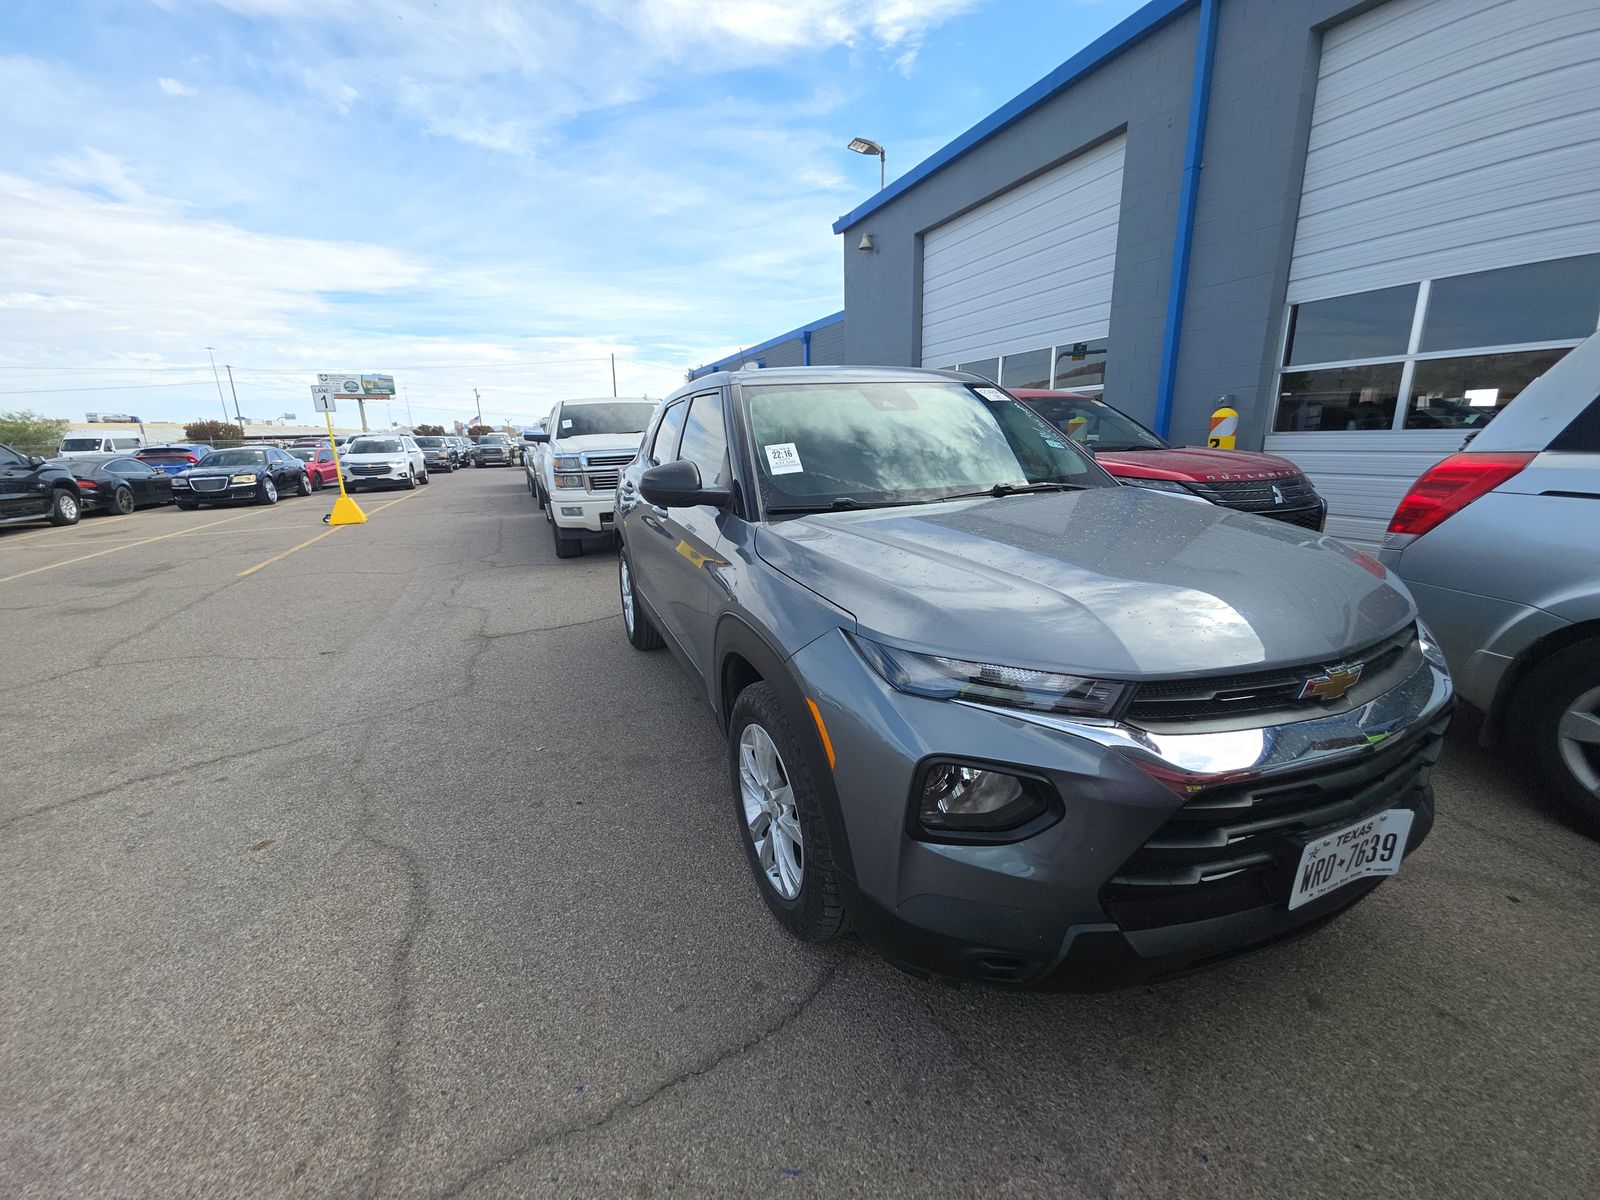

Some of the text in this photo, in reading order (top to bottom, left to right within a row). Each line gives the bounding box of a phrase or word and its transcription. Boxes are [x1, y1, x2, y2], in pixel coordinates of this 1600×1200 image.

[320, 394, 329, 409] 1
[1336, 822, 1374, 847] TEXAS
[1299, 832, 1398, 894] WRD 7639
